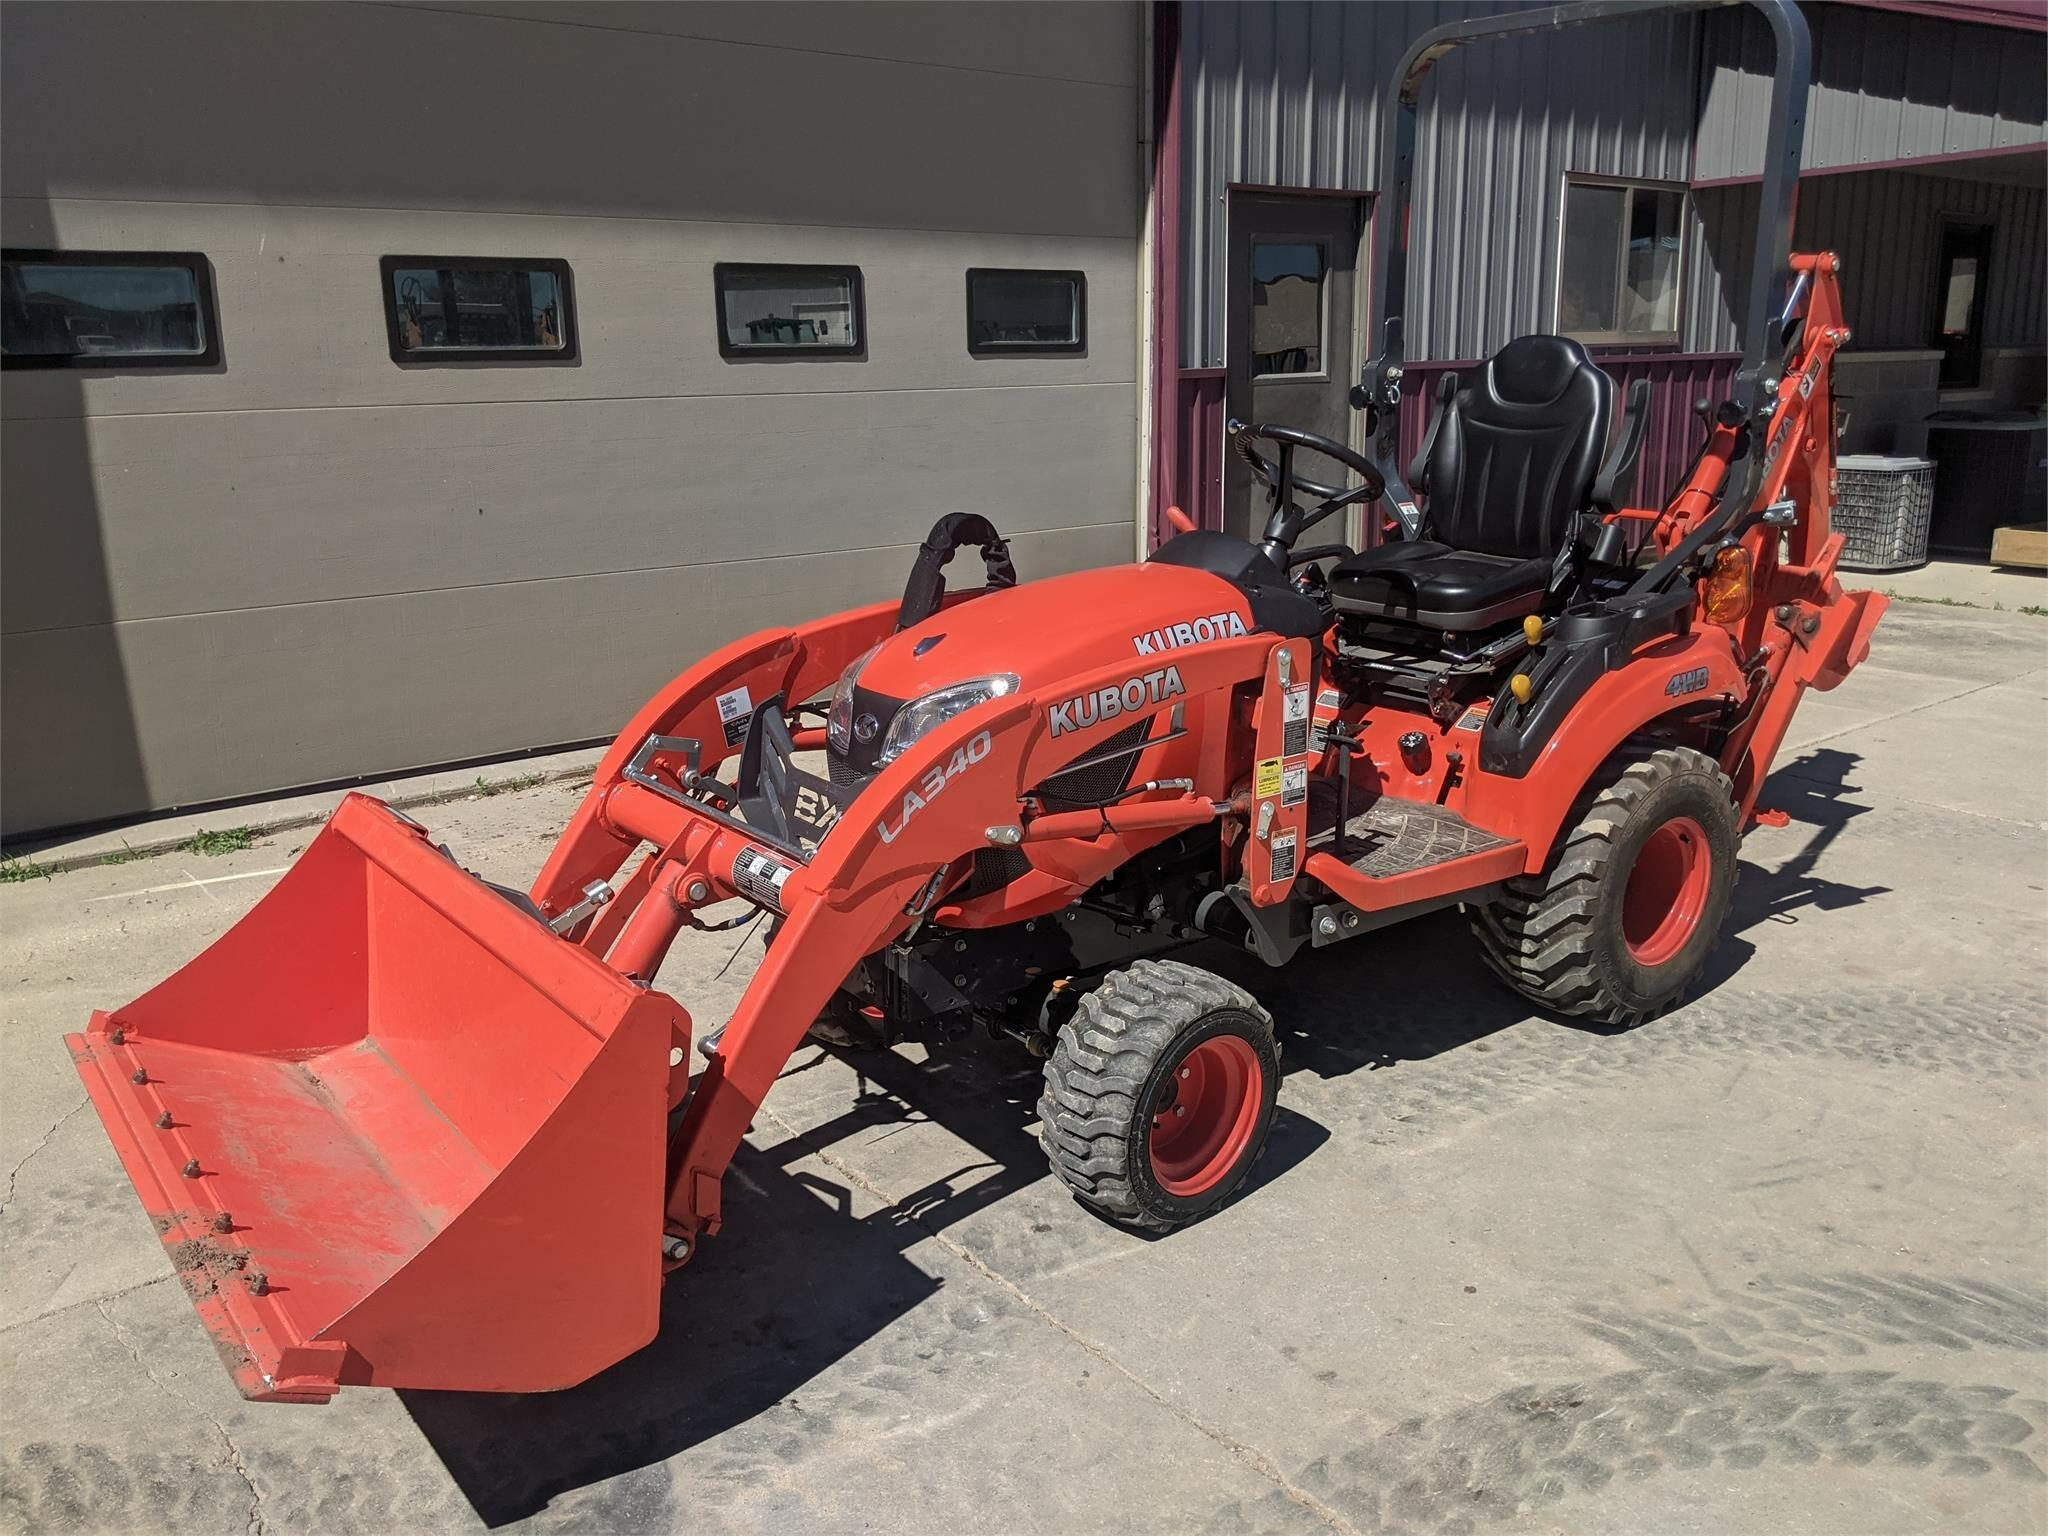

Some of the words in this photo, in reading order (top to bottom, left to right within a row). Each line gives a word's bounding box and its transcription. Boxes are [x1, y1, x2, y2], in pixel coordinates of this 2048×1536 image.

[1131, 611, 1248, 657] KUBOTA
[1048, 664, 1186, 739] KUBOTA
[1665, 666, 1709, 698] 4WD
[877, 730, 991, 844] LA340
